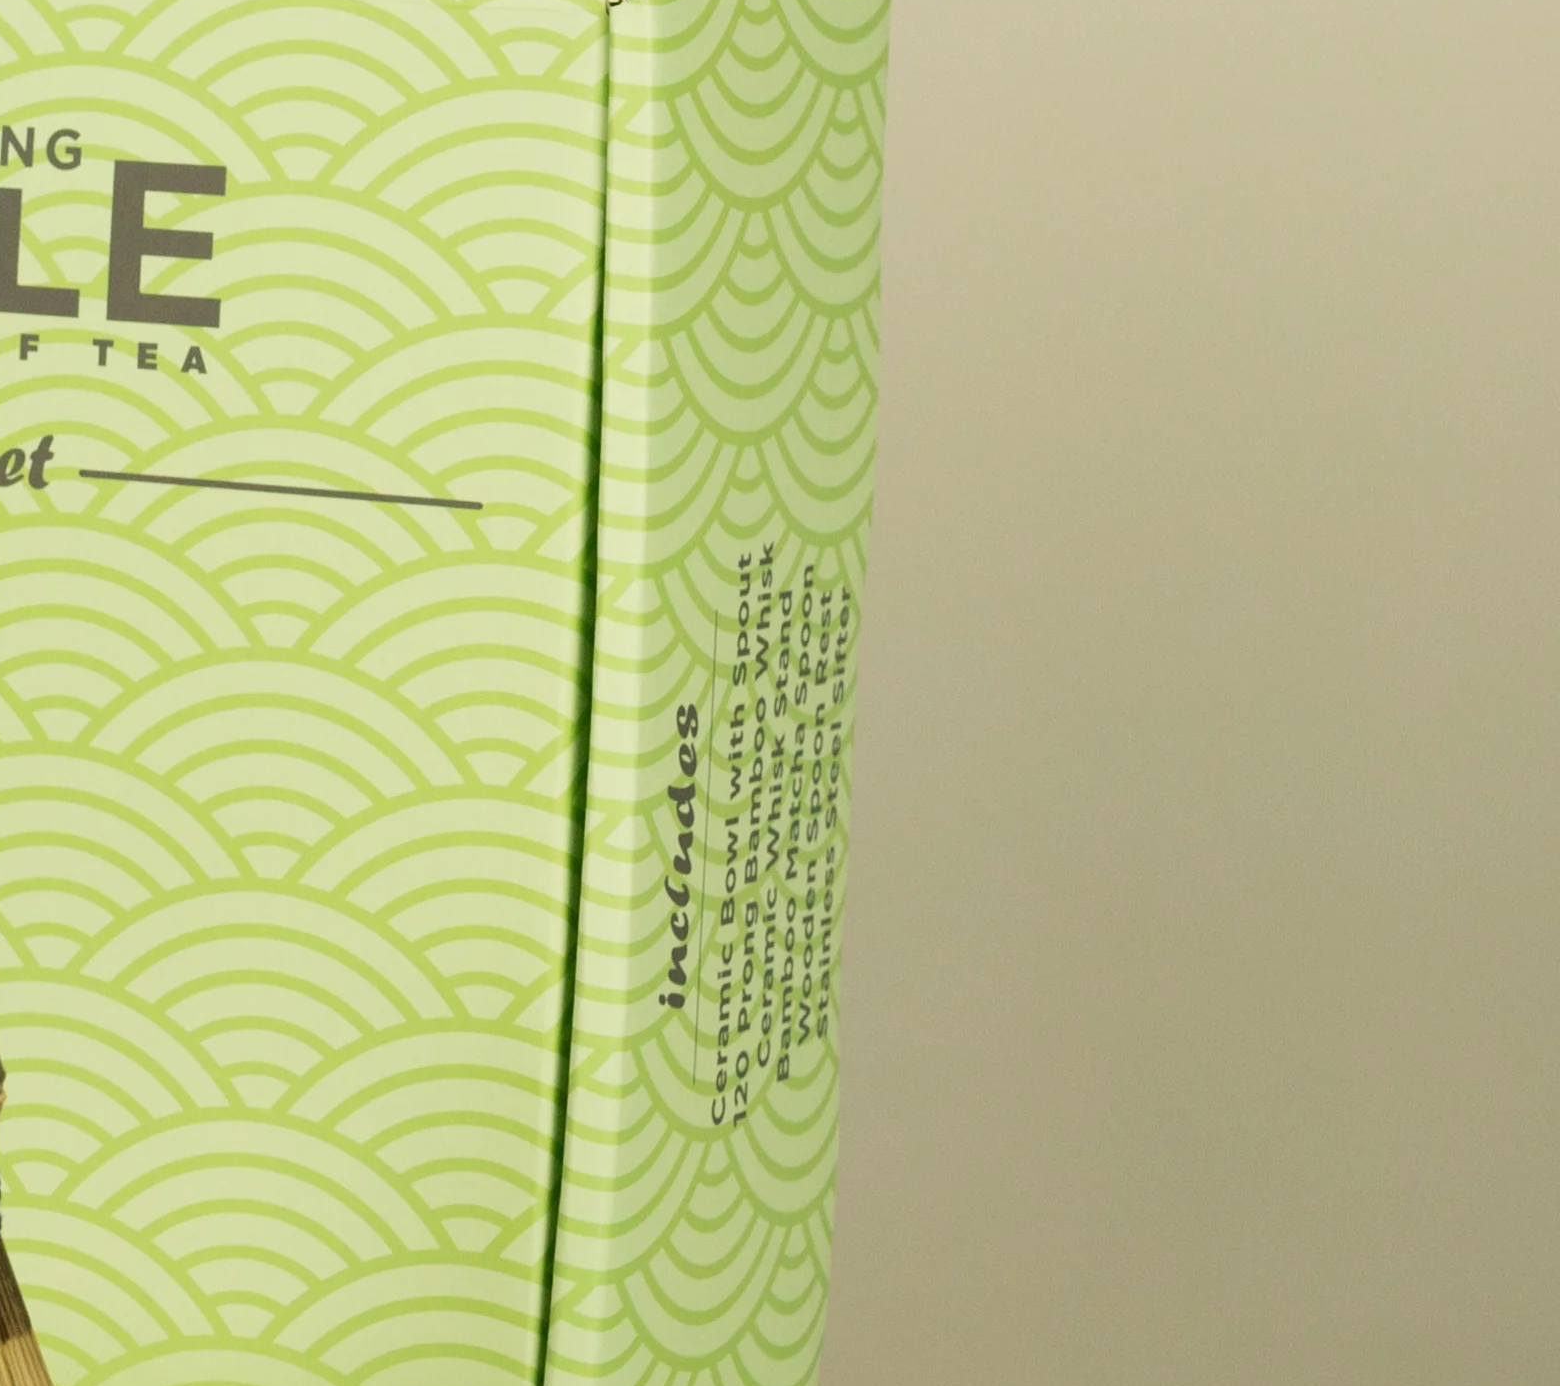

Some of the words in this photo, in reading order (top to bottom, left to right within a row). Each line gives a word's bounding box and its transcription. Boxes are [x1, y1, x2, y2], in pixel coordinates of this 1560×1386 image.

[92, 339, 208, 374] TEA
[732, 552, 751, 686] Spout
[754, 541, 774, 681] Whisk
[774, 590, 792, 717] Stand
[794, 565, 814, 706] Spoon
[815, 590, 832, 686] Rest
[833, 587, 851, 705] Sifter
[728, 703, 745, 801] with
[744, 697, 766, 885] Bamboo
[765, 734, 785, 872] Whisk
[785, 723, 805, 881] Matcha
[806, 703, 825, 843] Spoon
[825, 721, 842, 829] Steel
[658, 703, 699, 1010] includes
[720, 816, 740, 926] Bowl
[737, 900, 758, 1034] Prong
[757, 886, 777, 1067] Ceramic
[777, 897, 796, 1082] Bamboo
[798, 859, 817, 1046] Wooden
[817, 846, 834, 1039] Stainless
[711, 942, 734, 1126] Ceramic
[733, 1050, 750, 1128] 120
